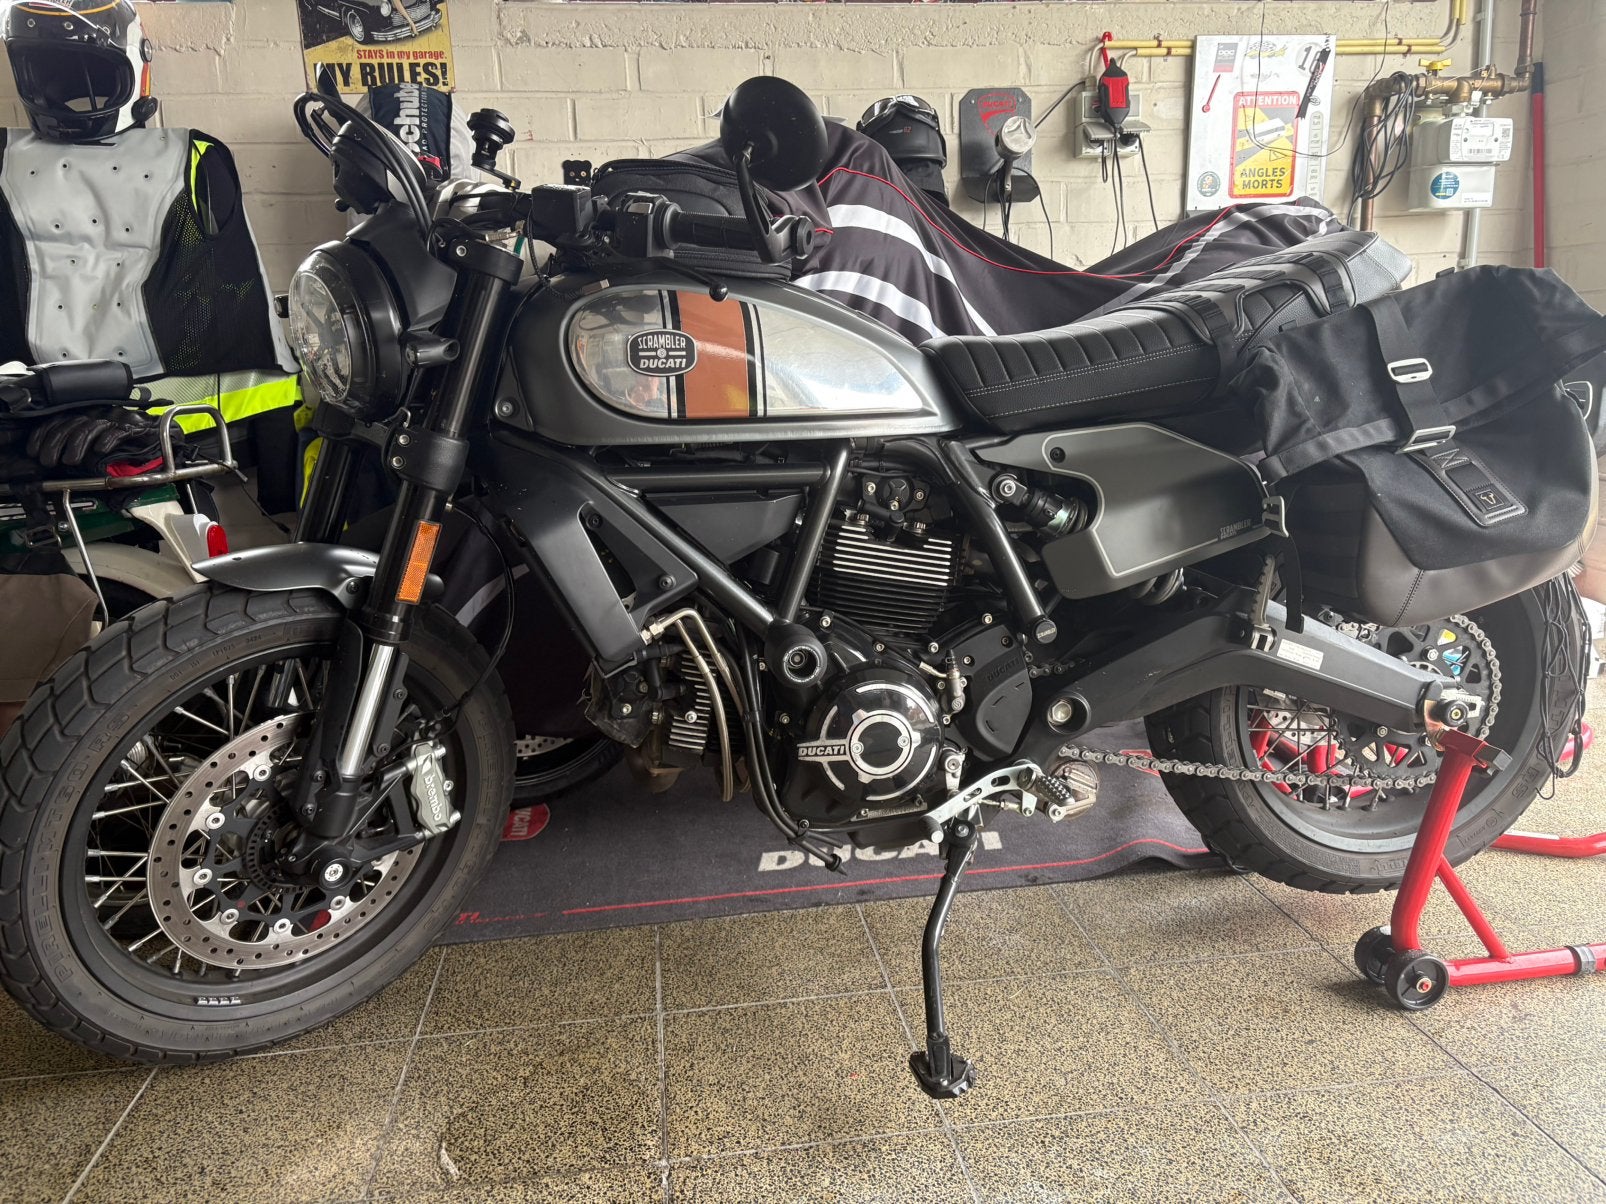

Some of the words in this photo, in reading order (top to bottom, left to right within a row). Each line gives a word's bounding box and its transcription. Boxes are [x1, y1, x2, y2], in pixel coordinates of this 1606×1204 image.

[357, 49, 384, 60] STAYS
[386, 49, 395, 60] in
[397, 50, 411, 61] my
[412, 50, 447, 61] garage.
[360, 61, 449, 88] RULES!
[1239, 95, 1297, 106] ATTENTION
[1240, 167, 1286, 178] ANGLES
[1242, 179, 1283, 190] MORTS
[637, 334, 686, 348] SCRAMBLER
[640, 359, 687, 368] DUCATI
[799, 745, 845, 756] DUCATI
[423, 774, 442, 821] brembo
[32, 862, 74, 984] PIRELLI
